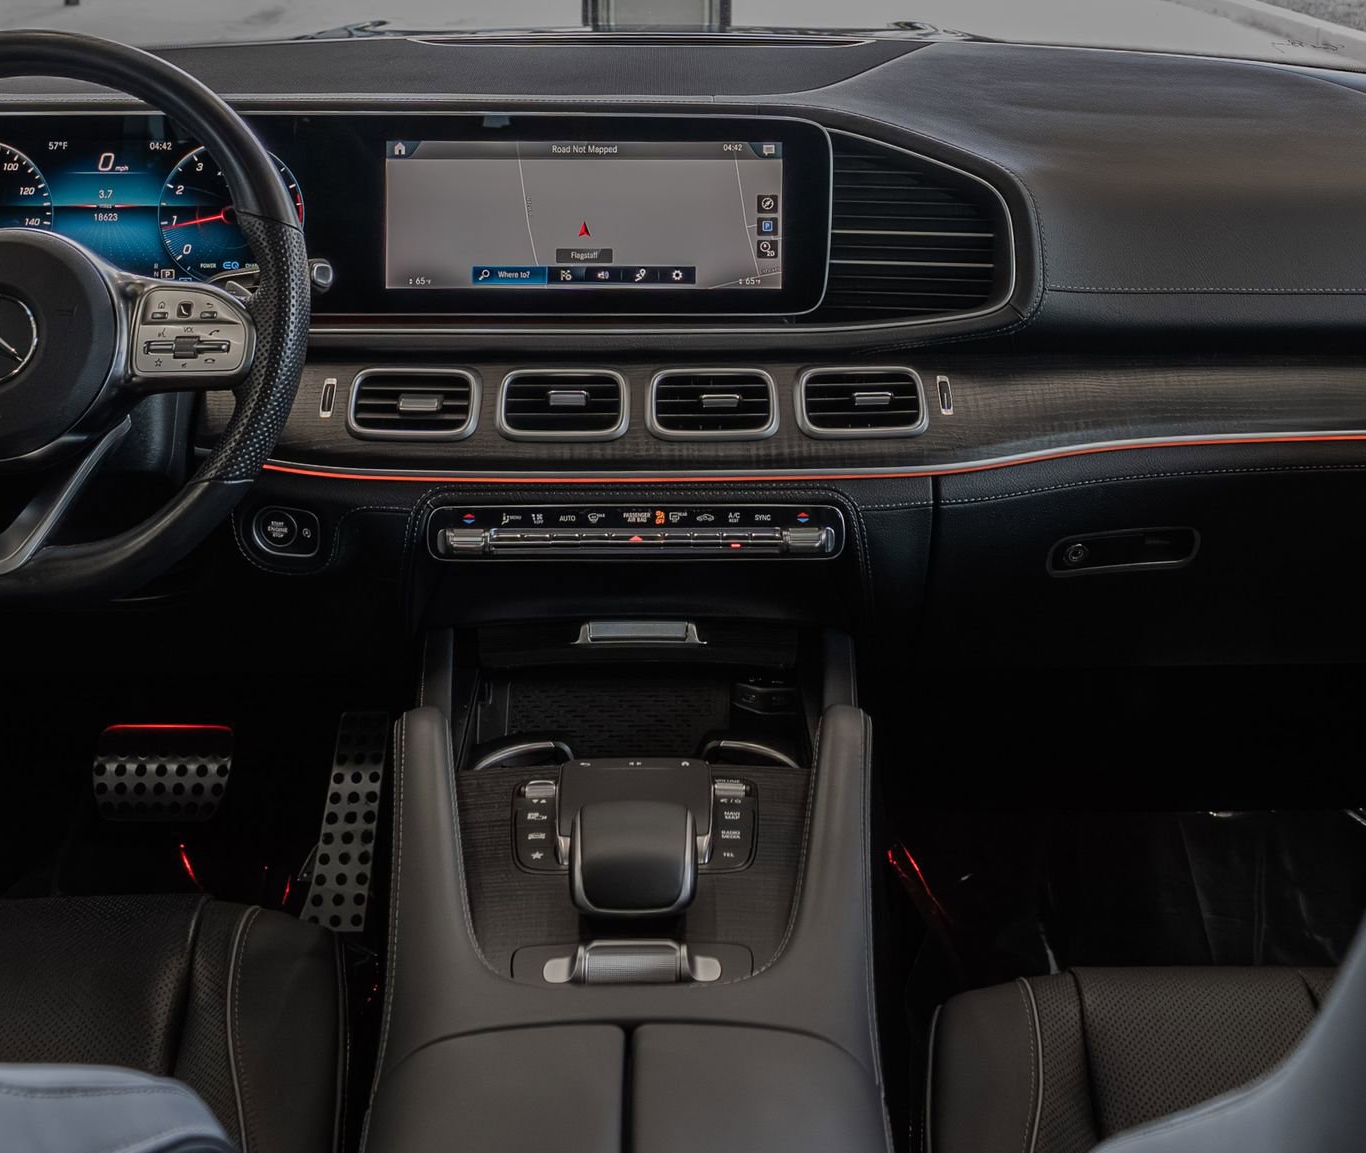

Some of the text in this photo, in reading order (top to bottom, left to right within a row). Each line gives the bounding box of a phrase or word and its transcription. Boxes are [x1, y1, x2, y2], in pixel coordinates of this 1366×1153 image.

[48, 142, 68, 150] 57°F
[149, 142, 172, 150] 04:42
[552, 145, 618, 155] Road Not Mapped
[723, 144, 743, 152] 04:42
[3, 162, 19, 171] 100
[98, 152, 115, 172] 0
[195, 163, 204, 172] 3
[19, 187, 35, 195] 120
[98, 189, 113, 199] 3.7
[175, 185, 185, 195] 2
[25, 218, 41, 226] 140
[94, 213, 118, 222] 18623
[171, 215, 178, 226] 1
[182, 244, 192, 255] 0
[571, 251, 598, 261] Flagstaff
[222, 261, 239, 270] EQ
[498, 271, 530, 279] Where to?
